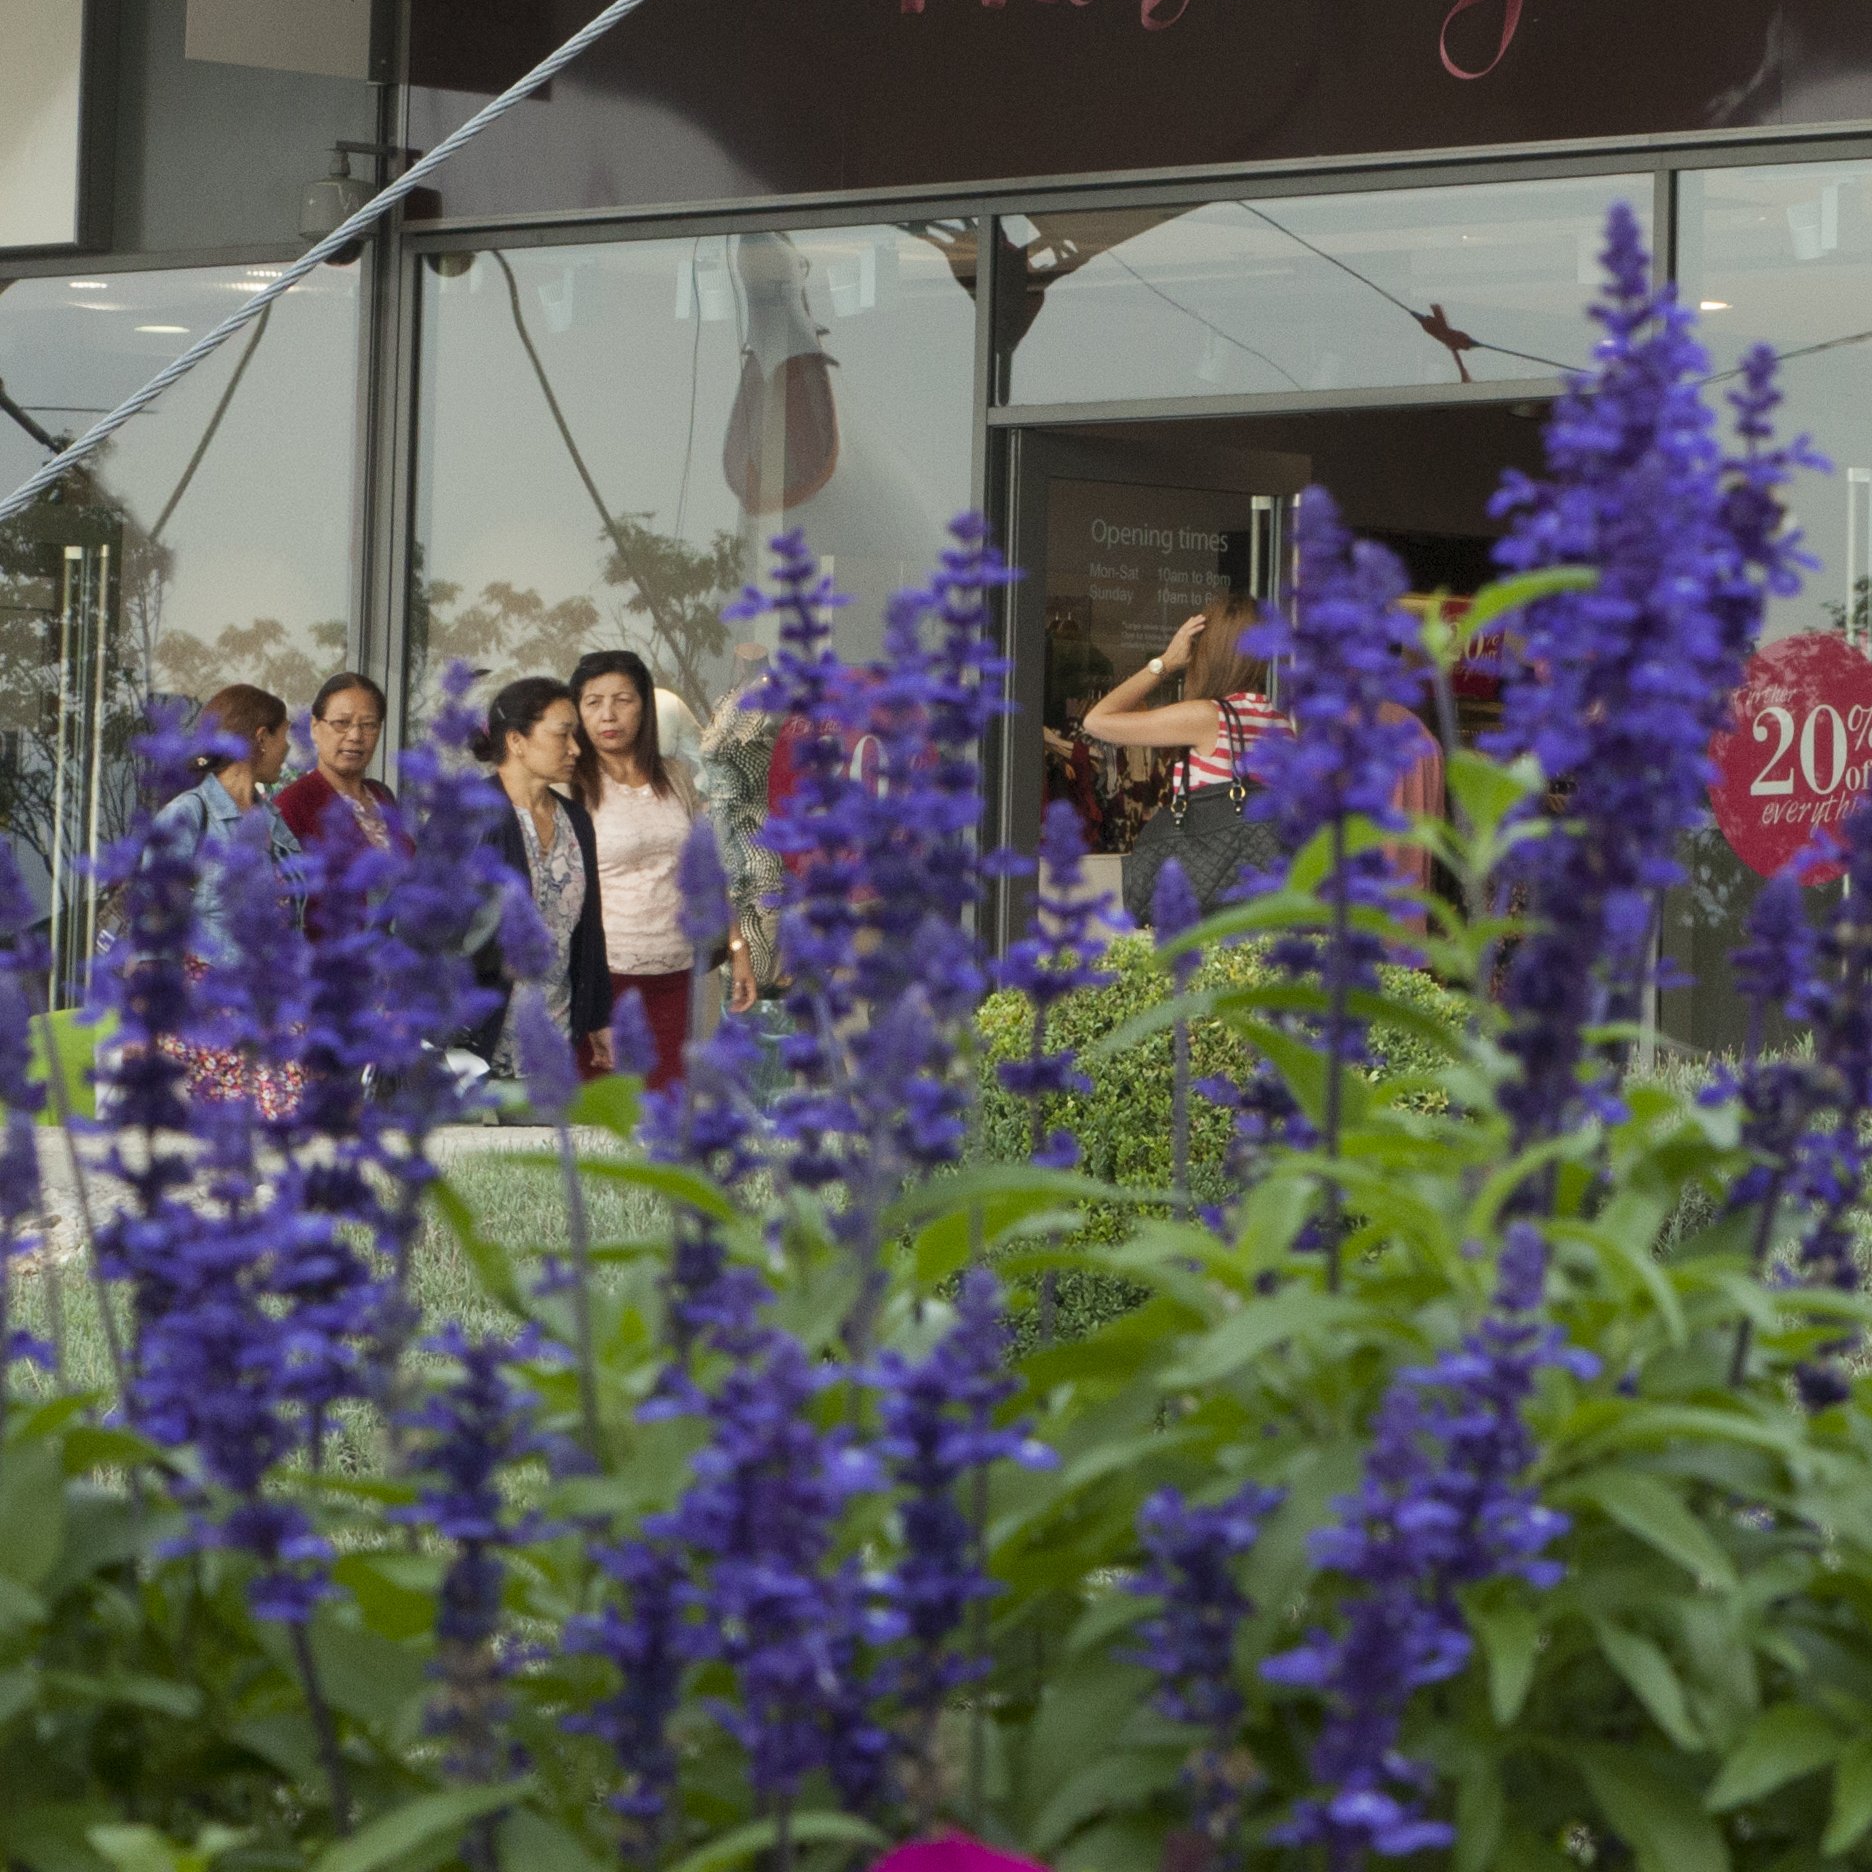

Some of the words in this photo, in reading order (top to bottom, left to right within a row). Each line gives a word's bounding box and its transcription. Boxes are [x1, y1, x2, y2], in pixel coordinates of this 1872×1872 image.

[1091, 518, 1174, 555] Opening
[1178, 524, 1229, 553] times
[1089, 562, 1139, 581] Mon-Sat
[1157, 567, 1189, 583] 10am
[1192, 570, 1203, 585] to
[1089, 584, 1134, 606] Sunday
[1157, 589, 1189, 604] 10am
[1191, 592, 1202, 606] to
[1761, 790, 1862, 839] everythi
